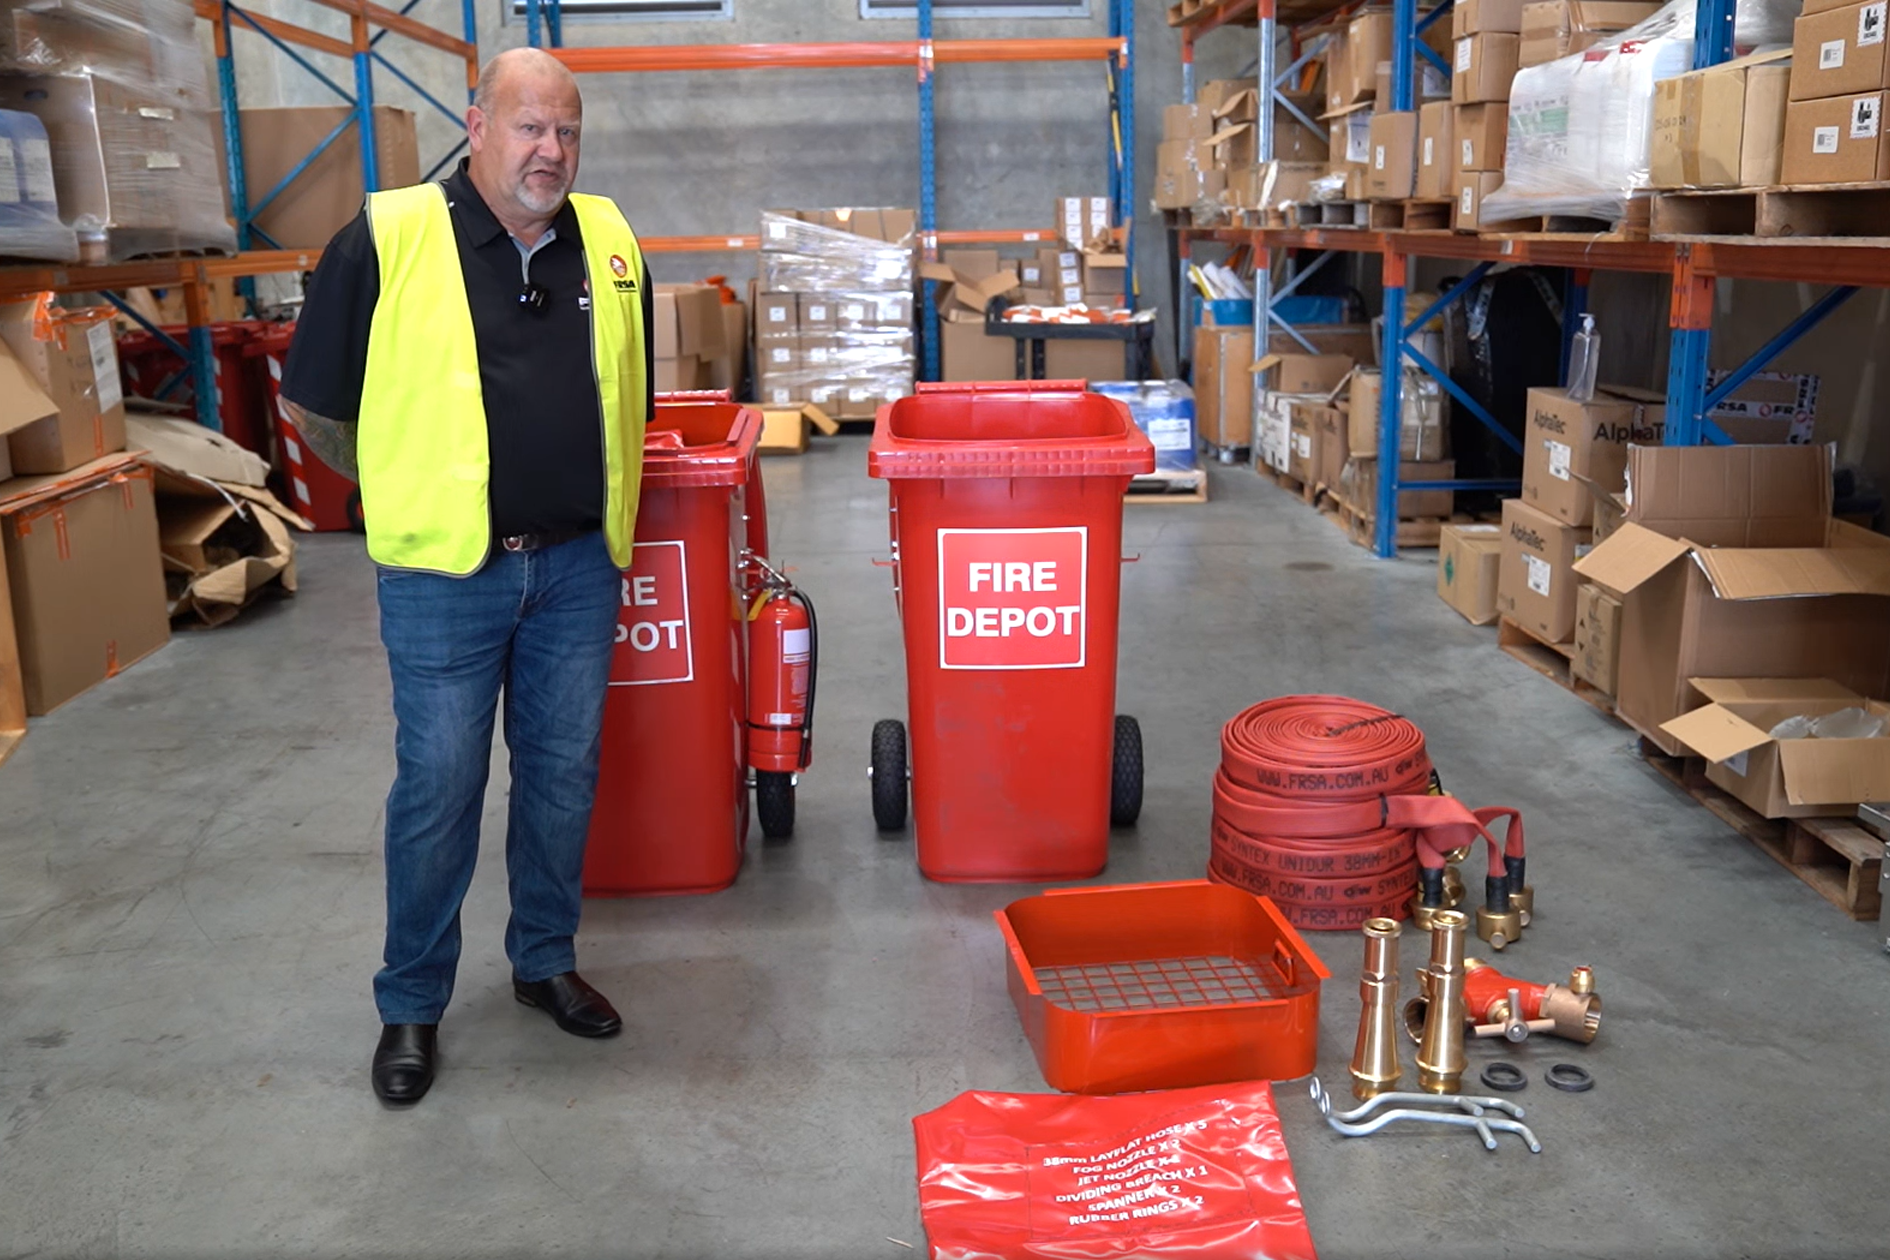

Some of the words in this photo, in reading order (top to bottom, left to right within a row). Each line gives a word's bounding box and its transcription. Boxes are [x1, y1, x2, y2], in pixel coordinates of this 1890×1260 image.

[1716, 401, 1748, 412] RSA
[1593, 422, 1664, 443] AlphaT
[969, 561, 1057, 592] FIRE
[614, 619, 684, 652] POT
[947, 605, 1081, 637] DEPOT
[1256, 768, 1389, 790] WWW.FRSA.COM.AU
[1230, 835, 1271, 866] SYNTEX
[1278, 855, 1334, 872] UNIDUR
[1043, 1156, 1087, 1167] 38mm
[1090, 1138, 1142, 1163] LAYFLAT
[1145, 1124, 1181, 1142] HOSE
[1184, 1121, 1196, 1132] X
[1198, 1119, 1208, 1130] 5
[1072, 1166, 1103, 1174] FOG
[1106, 1145, 1156, 1170] NOZZLE
[1158, 1140, 1169, 1152] X
[1056, 1182, 1122, 1202] DIVIDING
[1125, 1170, 1183, 1189] BREACH
[1185, 1167, 1196, 1179] X
[1199, 1165, 1208, 1176] 1
[1078, 1176, 1100, 1186] JET
[1103, 1159, 1156, 1181] NOZZLE
[1158, 1156, 1169, 1167] X
[1069, 1211, 1129, 1226] RUBBER
[1132, 1200, 1179, 1219] RINGS
[1181, 1196, 1192, 1208] X
[1194, 1195, 1204, 1205] 2
[1087, 1187, 1155, 1212] SPANNER
[1157, 1185, 1168, 1195] X
[1171, 1185, 1181, 1193] 2
